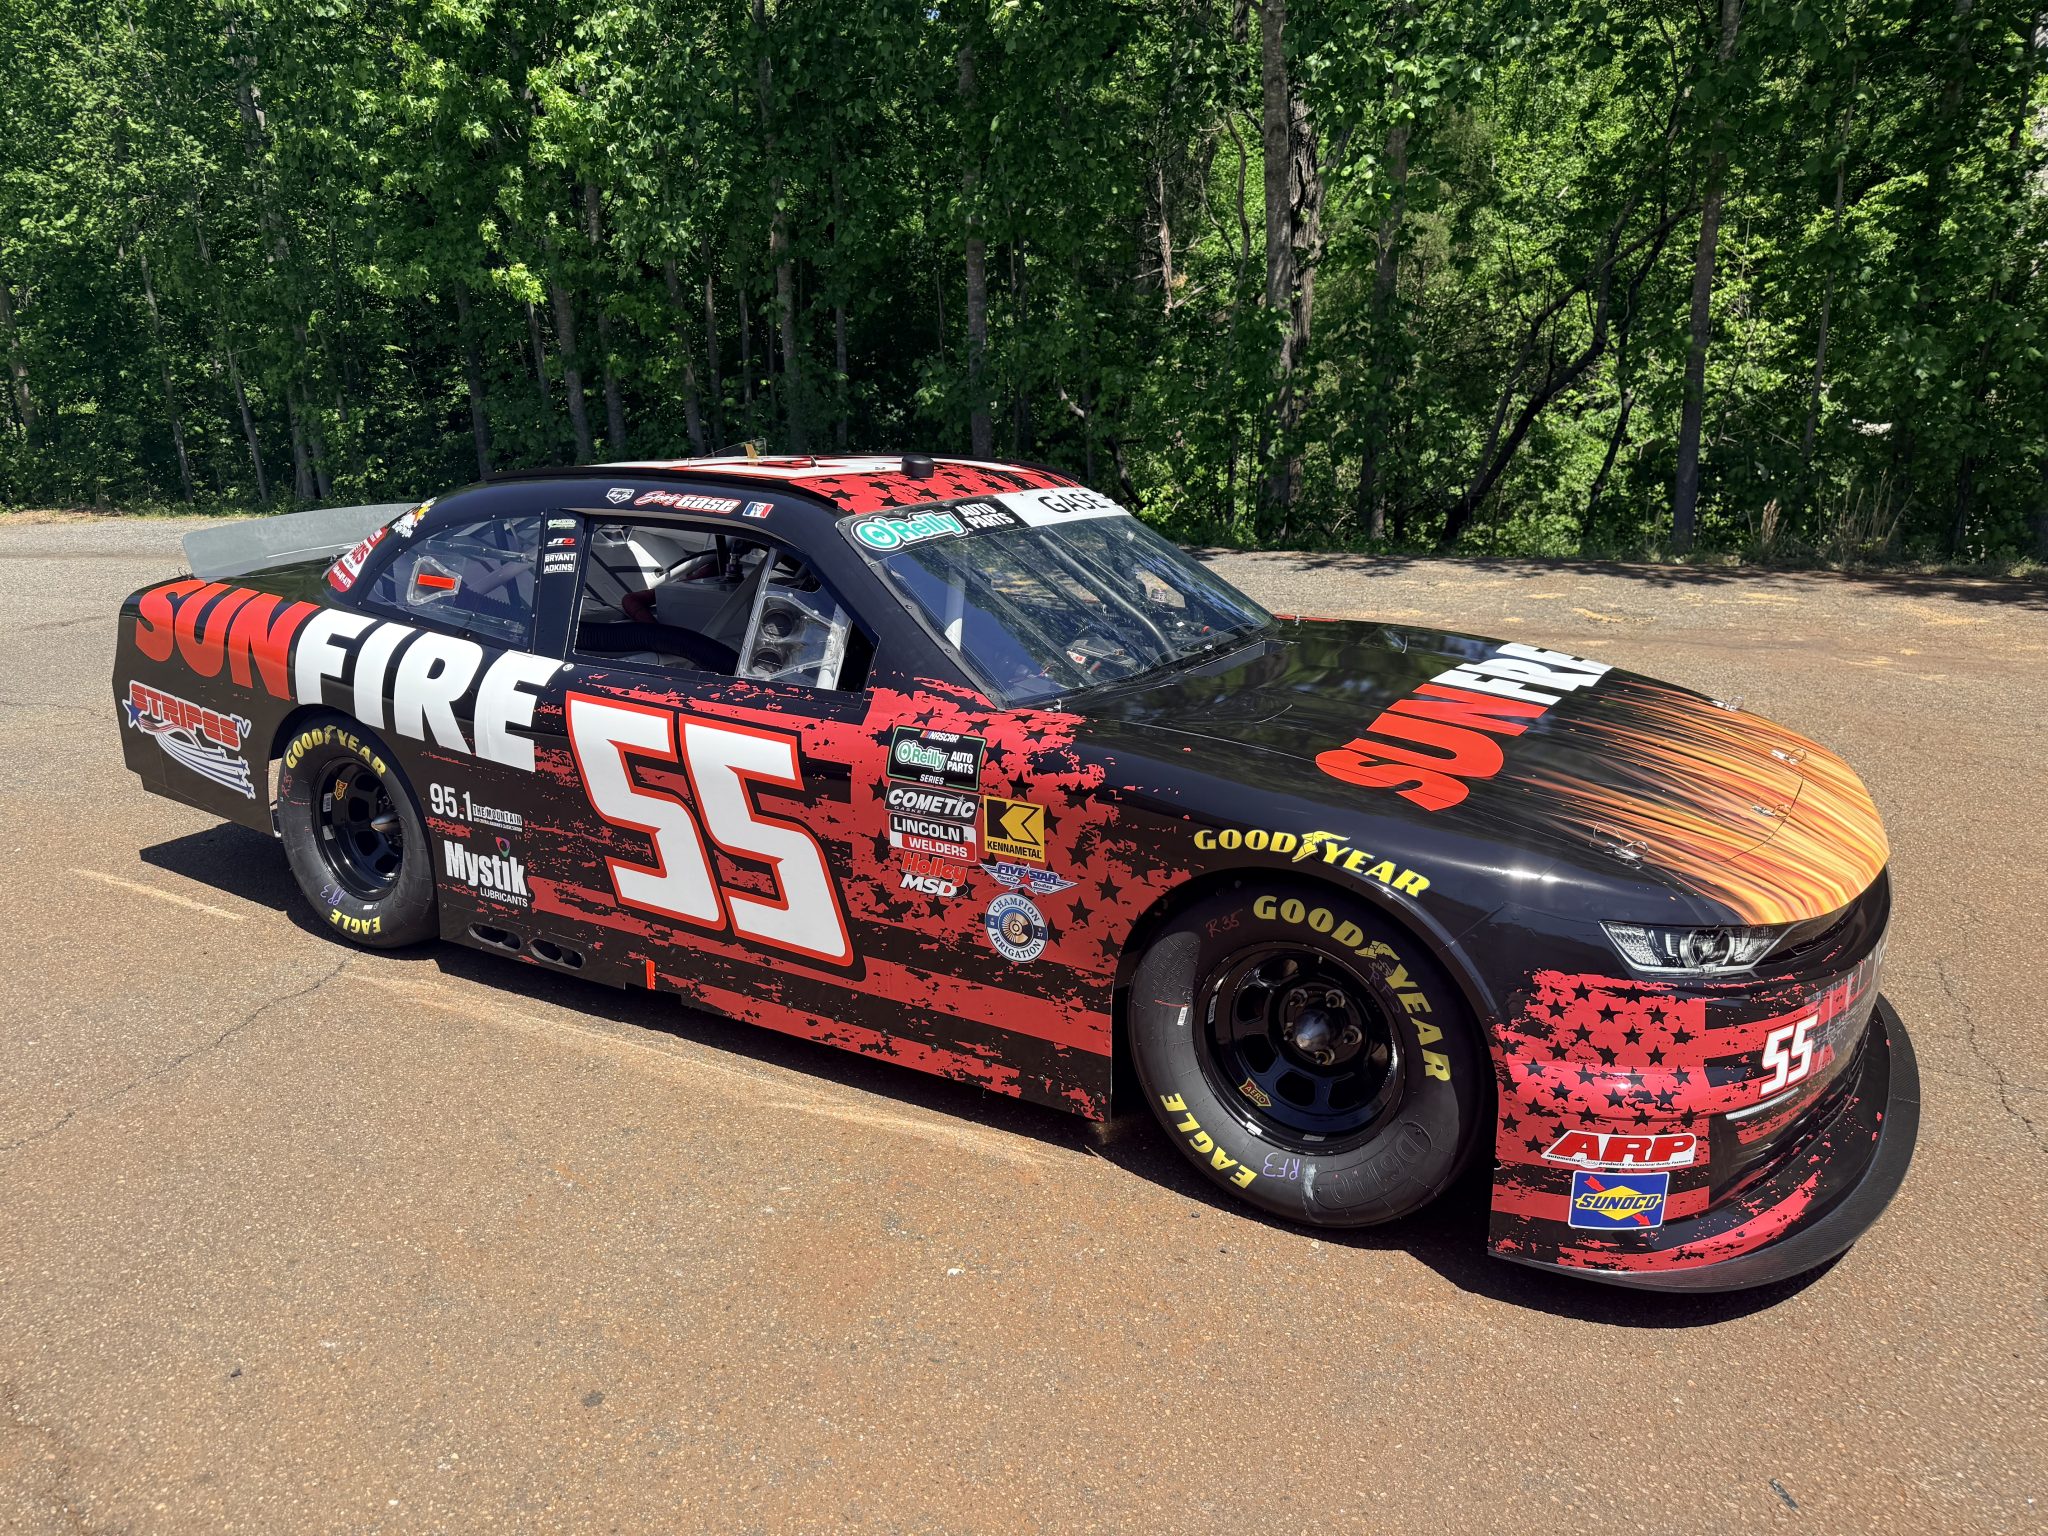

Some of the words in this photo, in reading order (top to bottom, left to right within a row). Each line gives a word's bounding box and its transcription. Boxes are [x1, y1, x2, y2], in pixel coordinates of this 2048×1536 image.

[956, 503, 996, 518] AUTO
[1038, 493, 1110, 514] GASE
[854, 511, 966, 549] O'Reilly
[964, 511, 1016, 529] PARTS
[545, 553, 575, 563] BRYANT
[545, 563, 574, 572] ADKINS
[928, 731, 960, 743] NASCAR
[898, 741, 946, 771] O'Reilly
[946, 760, 974, 775] PARTS
[950, 750, 974, 764] AUTO
[919, 773, 945, 785] SERIES
[429, 782, 473, 822] 95.1
[888, 788, 976, 818] COMETIC
[893, 805, 927, 815] GASKET
[565, 690, 854, 967] 55
[893, 816, 960, 842] LINCOLN
[908, 836, 968, 858] WELDERS
[986, 840, 1042, 860] KENNAMETAL
[443, 839, 528, 897] Mystik
[901, 850, 968, 888] Holley
[997, 864, 1025, 878] FIVE
[1028, 869, 1058, 885] STAR
[480, 886, 529, 908] LUBRICANTS
[899, 874, 957, 898] MSD
[992, 896, 1040, 922] CHAMPION
[329, 908, 382, 935] EAGLE
[991, 932, 1042, 959] IRRIGATION
[1759, 1013, 1819, 1100] 55
[1244, 1082, 1268, 1106] AERO
[1159, 1092, 1258, 1190] EAGLE
[1550, 1132, 1695, 1163] ARP
[1579, 1195, 1660, 1210] SUNOCO
